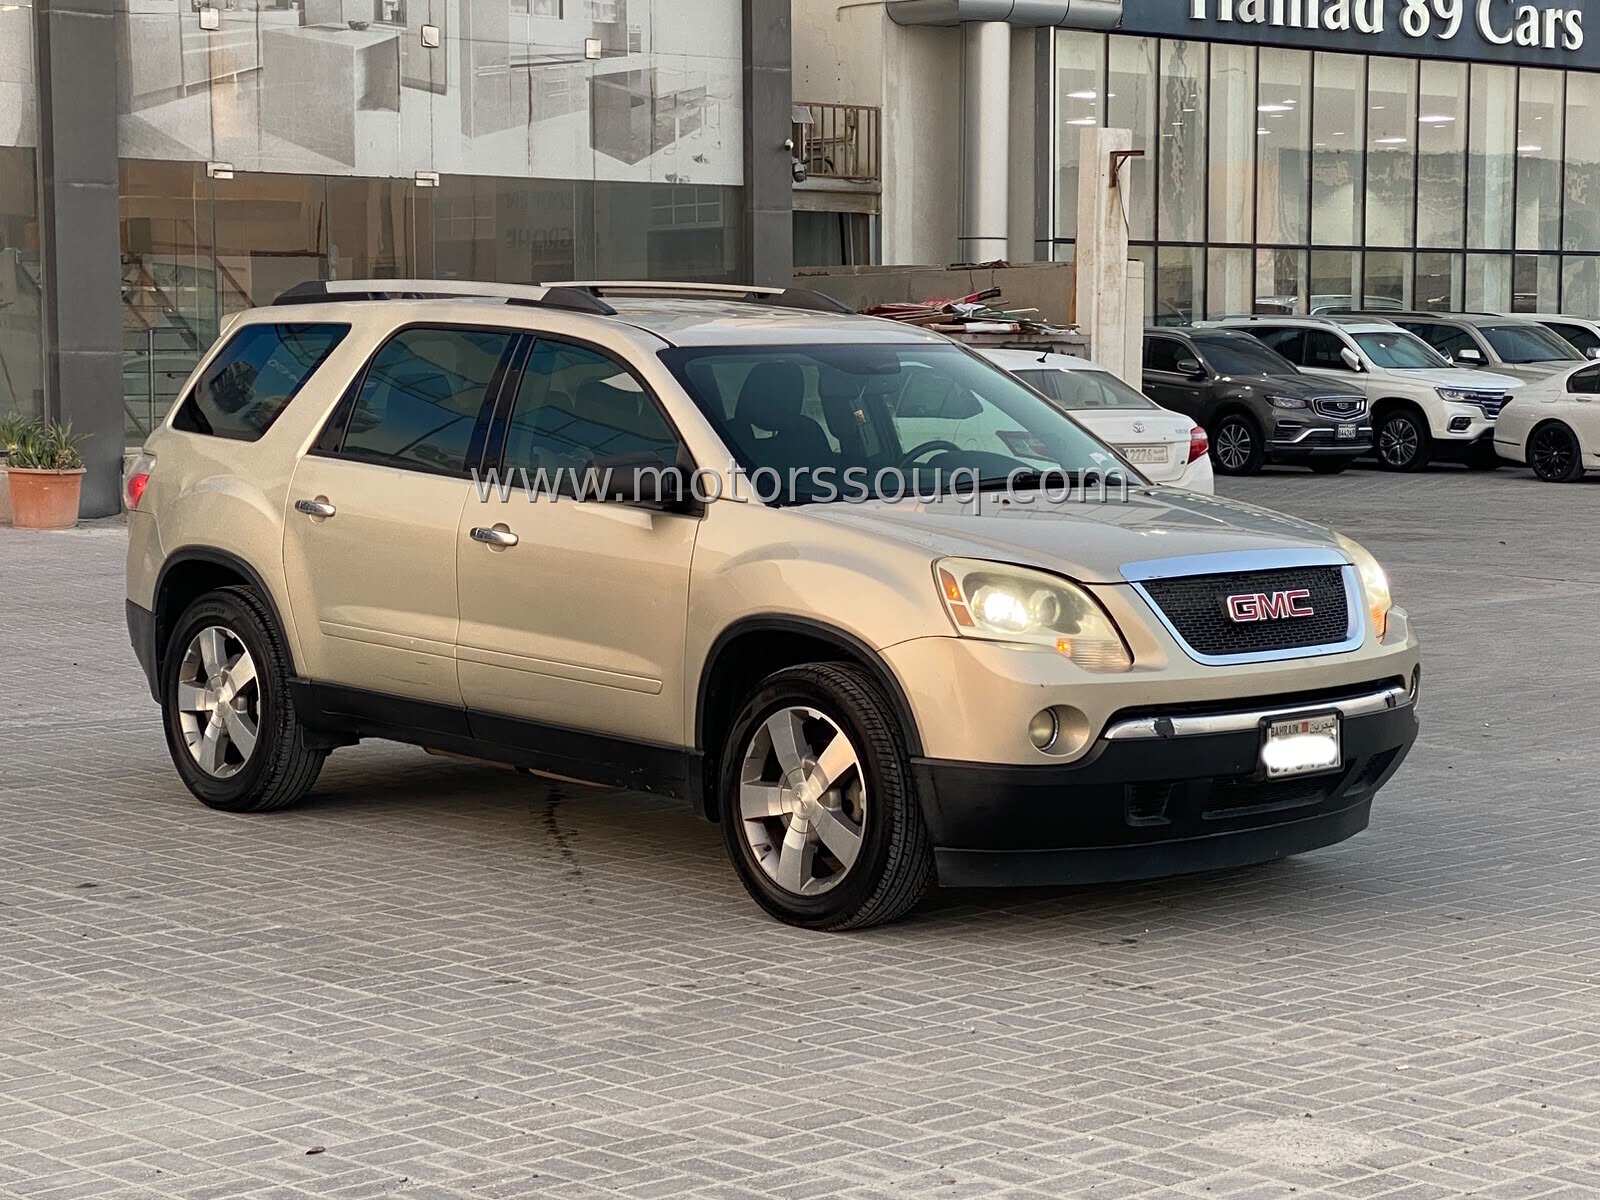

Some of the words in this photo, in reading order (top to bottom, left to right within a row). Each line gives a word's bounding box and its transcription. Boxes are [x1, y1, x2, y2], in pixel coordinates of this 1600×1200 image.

[1399, 0, 1464, 40] 89
[1475, 0, 1585, 51] Cars
[1227, 588, 1315, 622] GMC
[1270, 724, 1299, 738] BAHRAIN
[1309, 717, 1335, 734] لبحرين
